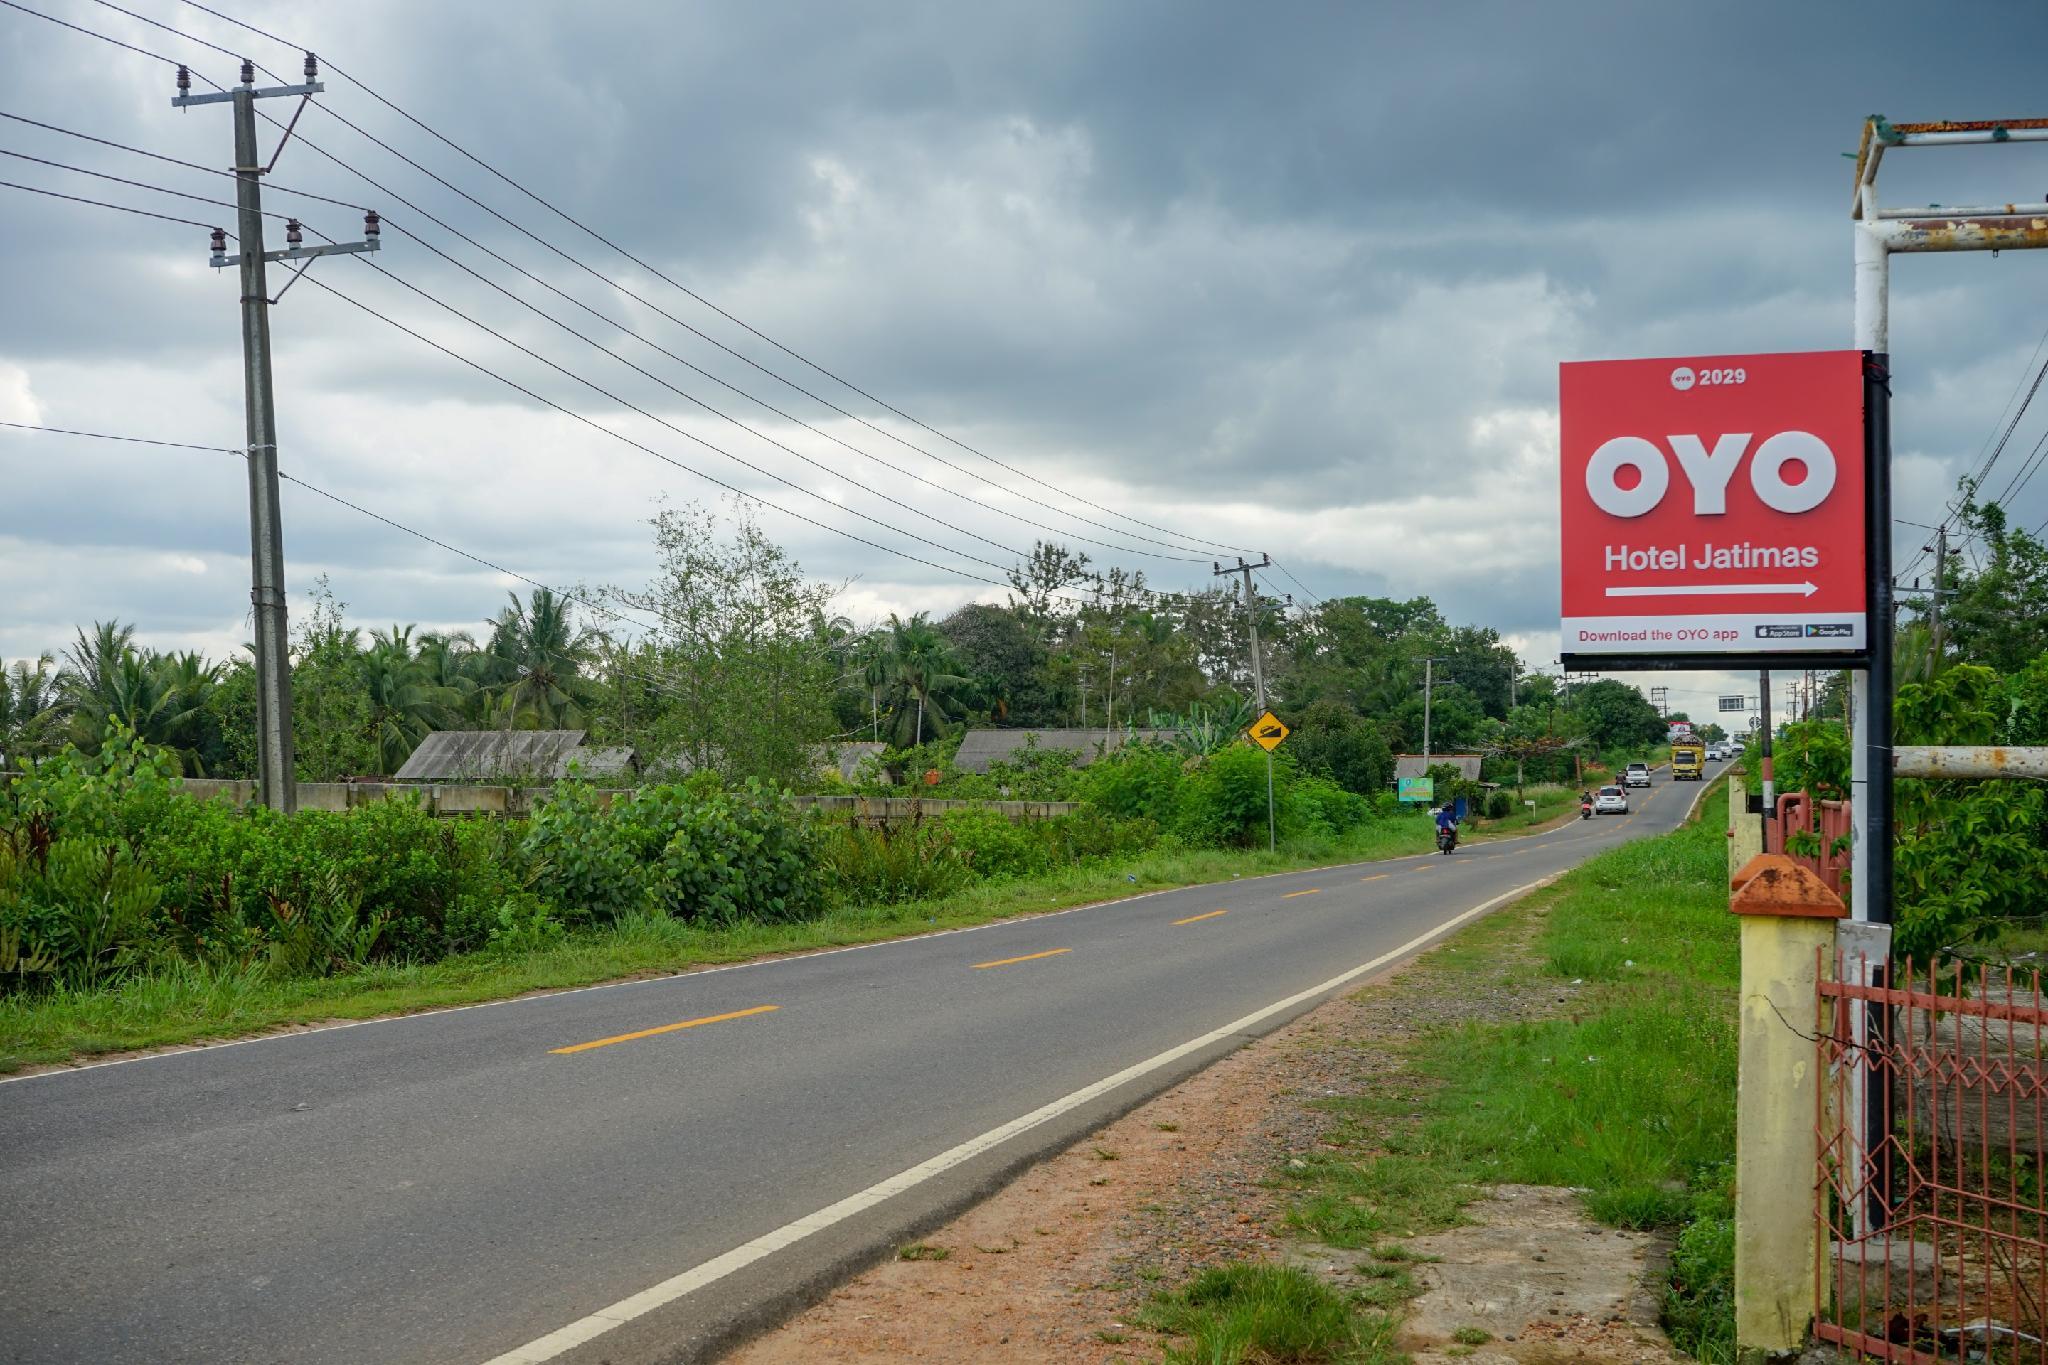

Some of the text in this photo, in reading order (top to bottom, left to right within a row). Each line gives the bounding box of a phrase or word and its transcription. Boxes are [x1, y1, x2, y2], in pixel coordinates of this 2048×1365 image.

[1699, 368, 1747, 386] 2029
[1585, 431, 1837, 517] OYO
[1605, 542, 1819, 571] Hotel Jatimas
[1579, 629, 1739, 642] Download the OYO app
[1819, 628, 1851, 637] Google Play
